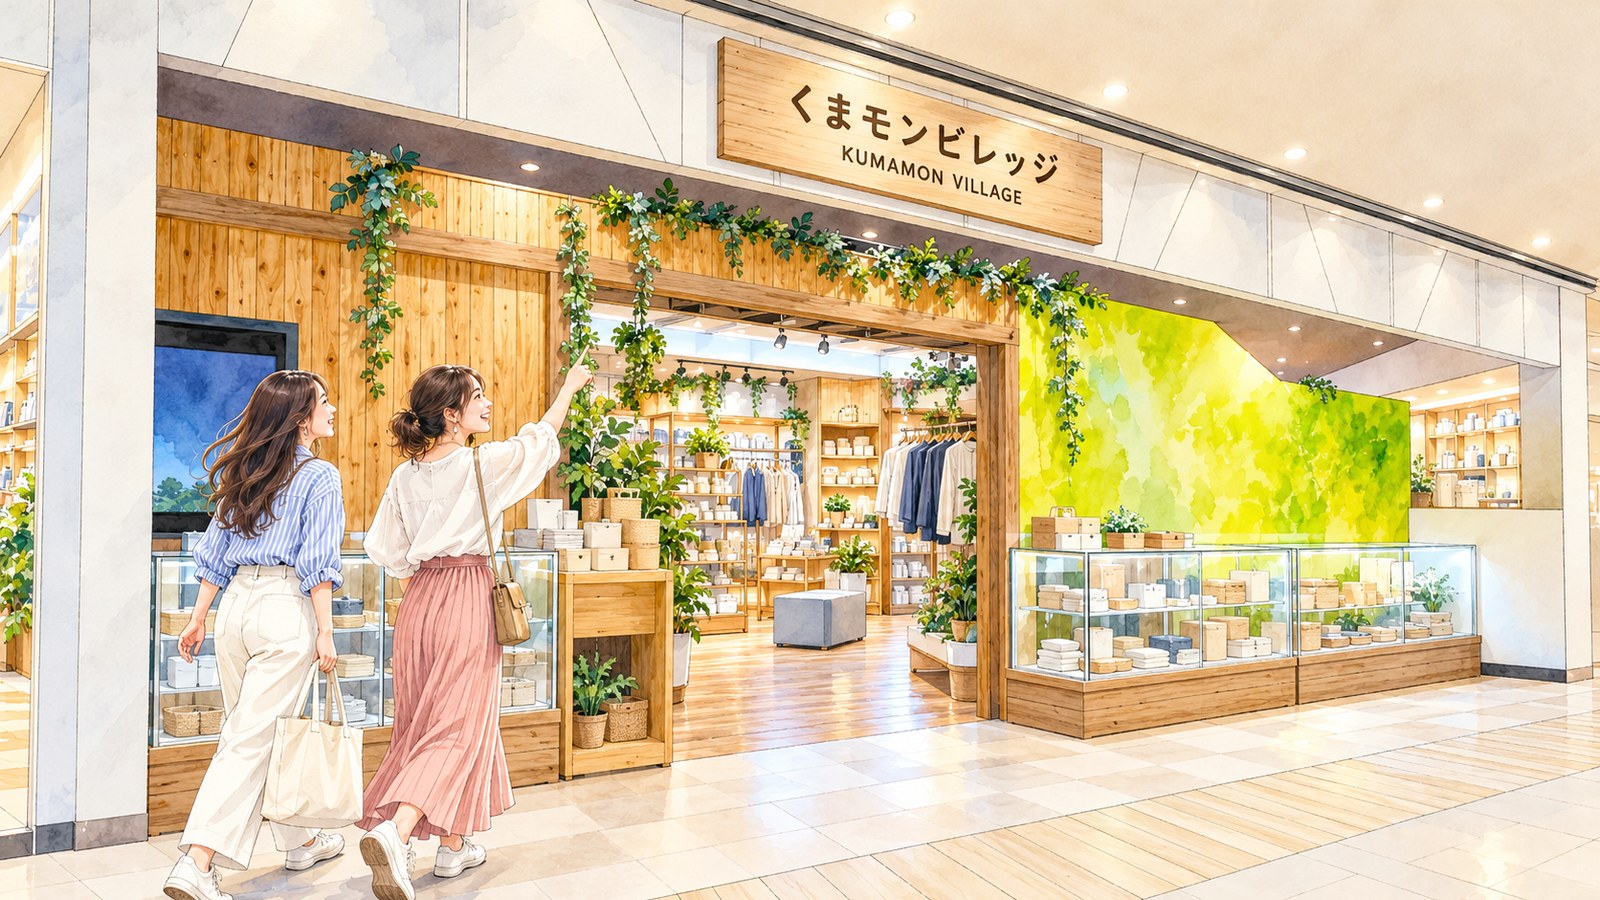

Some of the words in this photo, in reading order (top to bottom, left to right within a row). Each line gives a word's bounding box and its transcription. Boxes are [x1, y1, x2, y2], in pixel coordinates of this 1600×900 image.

[791, 85, 1059, 184] くまモンビレッジ
[842, 145, 944, 185] KUMAMON
[952, 173, 1023, 206] VILLAGE
